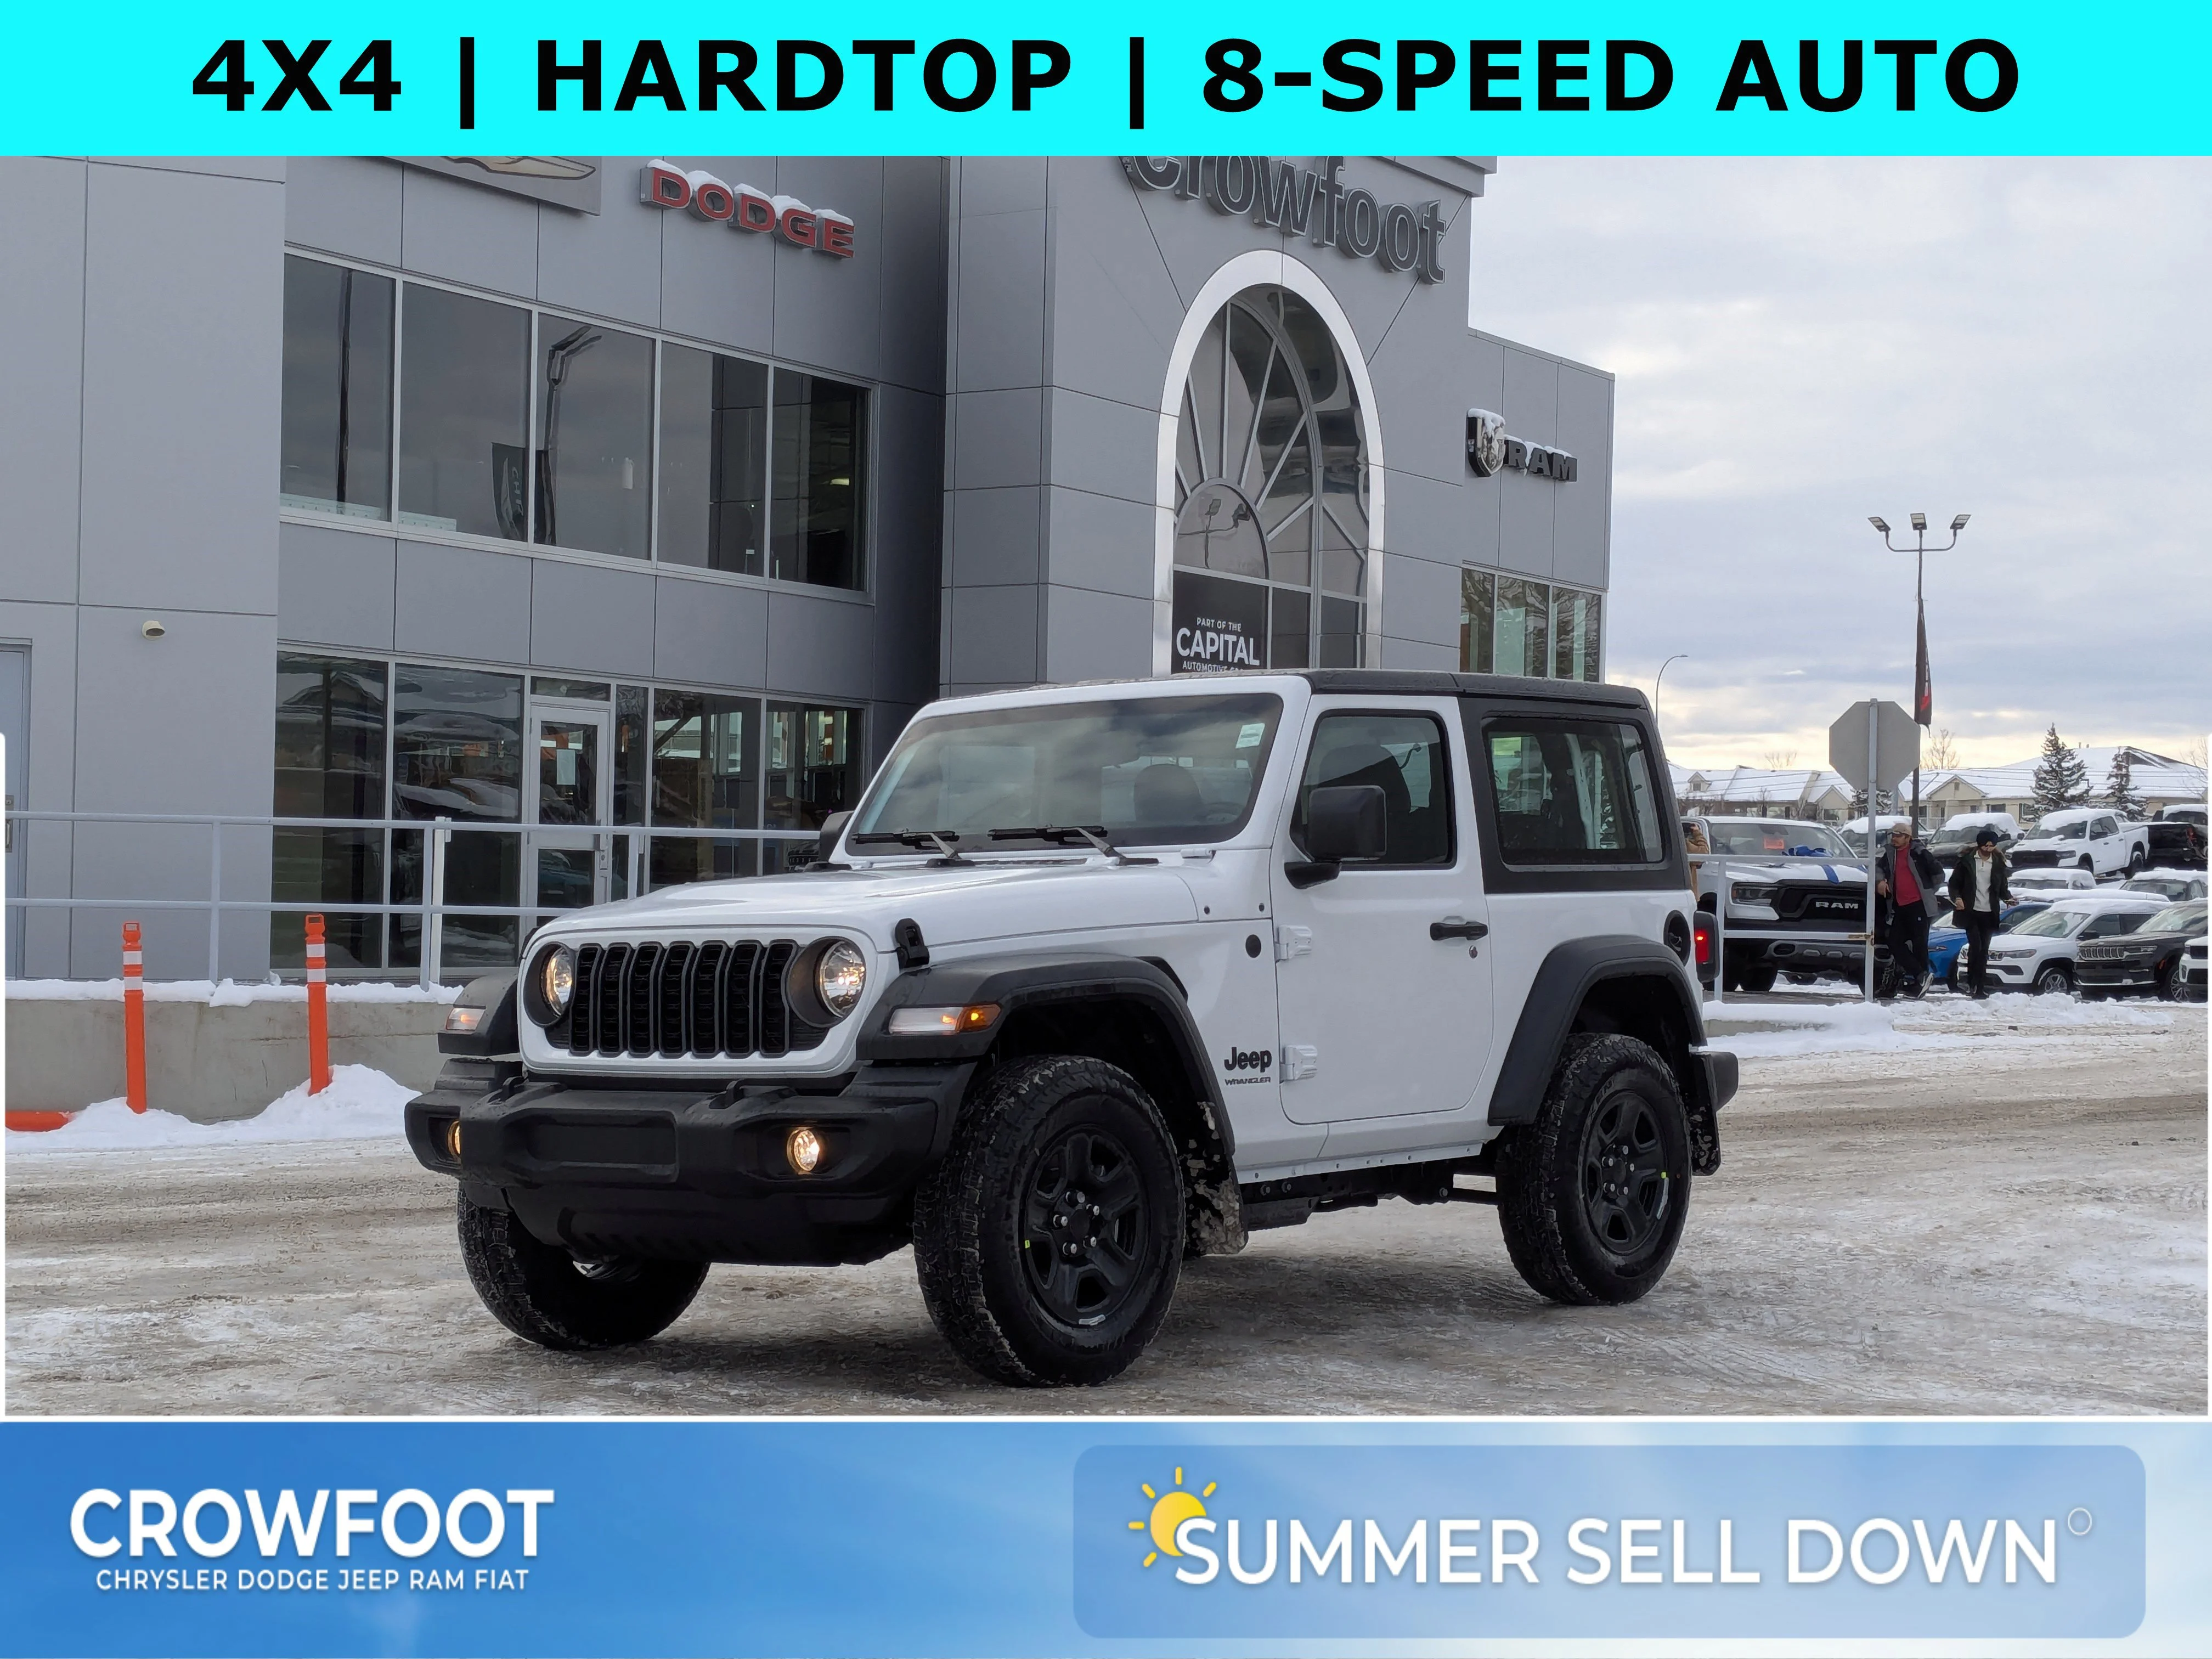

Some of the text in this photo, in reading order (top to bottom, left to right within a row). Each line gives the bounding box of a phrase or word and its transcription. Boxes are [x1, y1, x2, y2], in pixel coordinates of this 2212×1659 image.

[643, 166, 855, 258] DODGE
[1506, 438, 1578, 482] RAM
[1196, 617, 1215, 628] PART
[1176, 627, 1260, 666] CAPITAL
[1224, 1046, 1272, 1073] Jeep
